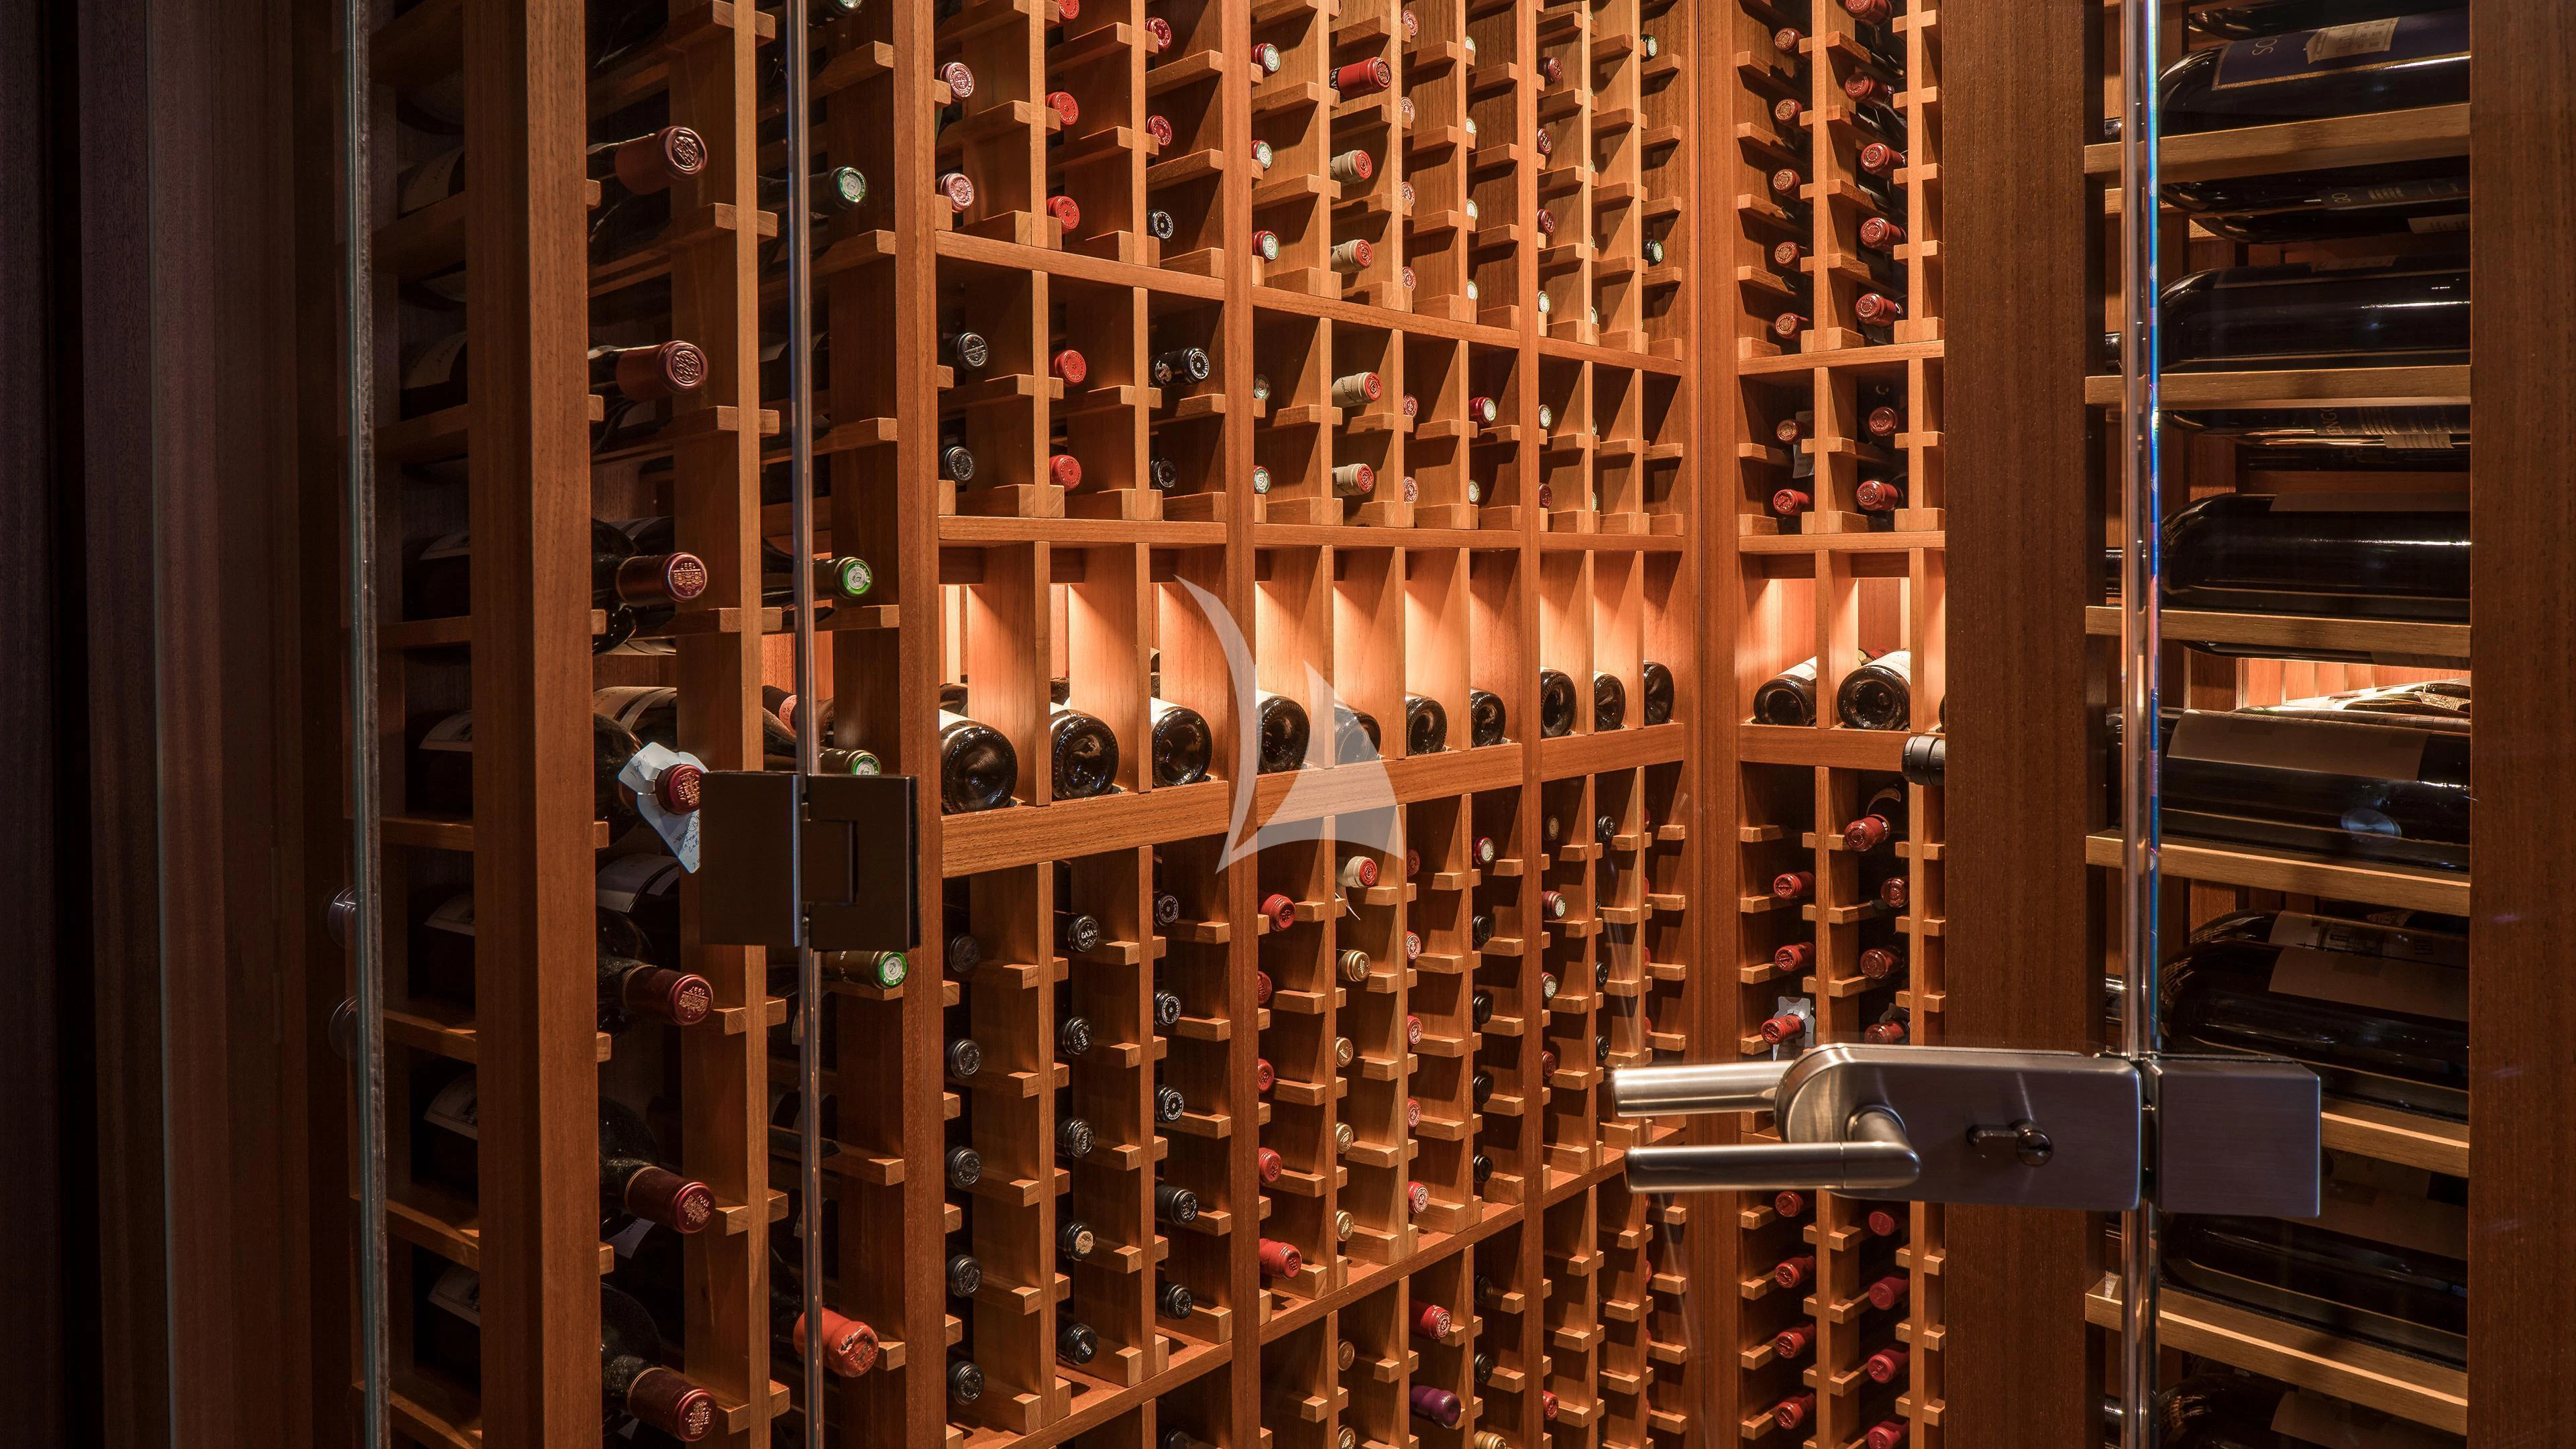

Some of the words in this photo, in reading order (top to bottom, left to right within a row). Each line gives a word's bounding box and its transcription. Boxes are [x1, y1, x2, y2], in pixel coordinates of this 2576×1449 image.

[1081, 930, 1093, 938] GAJA
[1079, 1029, 1087, 1046] GAJA
[1081, 1341, 1091, 1355] GAJA
